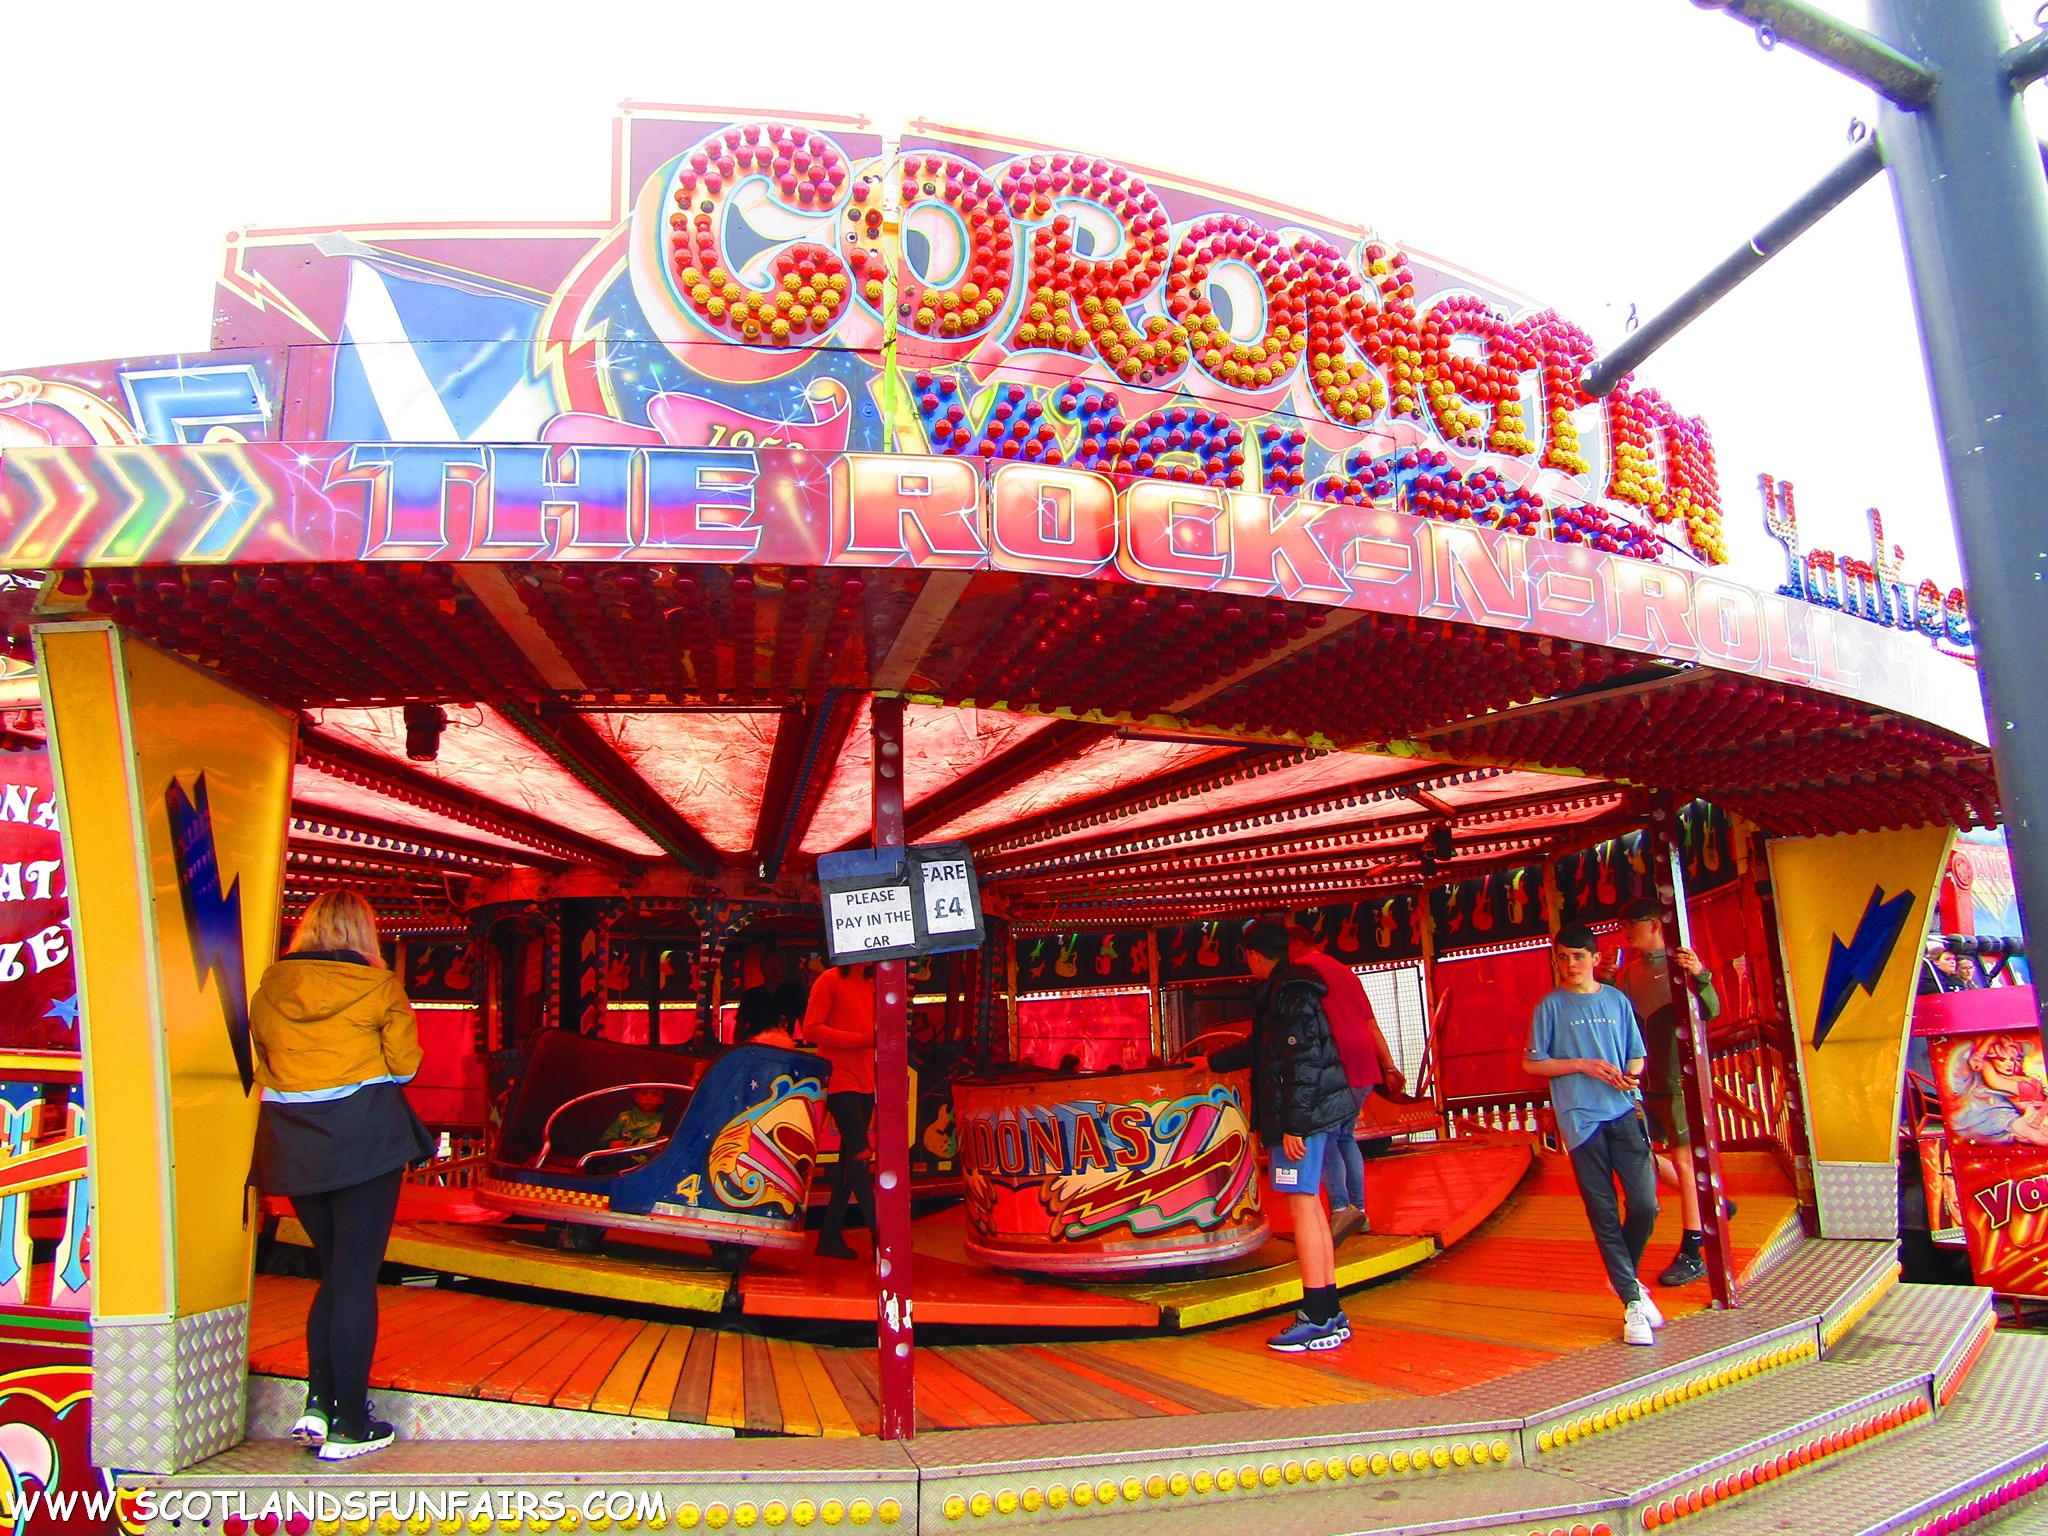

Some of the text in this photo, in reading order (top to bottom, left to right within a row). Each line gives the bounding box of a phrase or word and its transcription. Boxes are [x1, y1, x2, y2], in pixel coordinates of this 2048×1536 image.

[325, 443, 763, 562] THE
[921, 863, 966, 883] FARE
[846, 889, 896, 906] PLEASE
[934, 896, 964, 919] £4
[836, 910, 912, 930] PAY IN THE
[864, 935, 890, 949] CAR
[676, 1173, 702, 1207] 4
